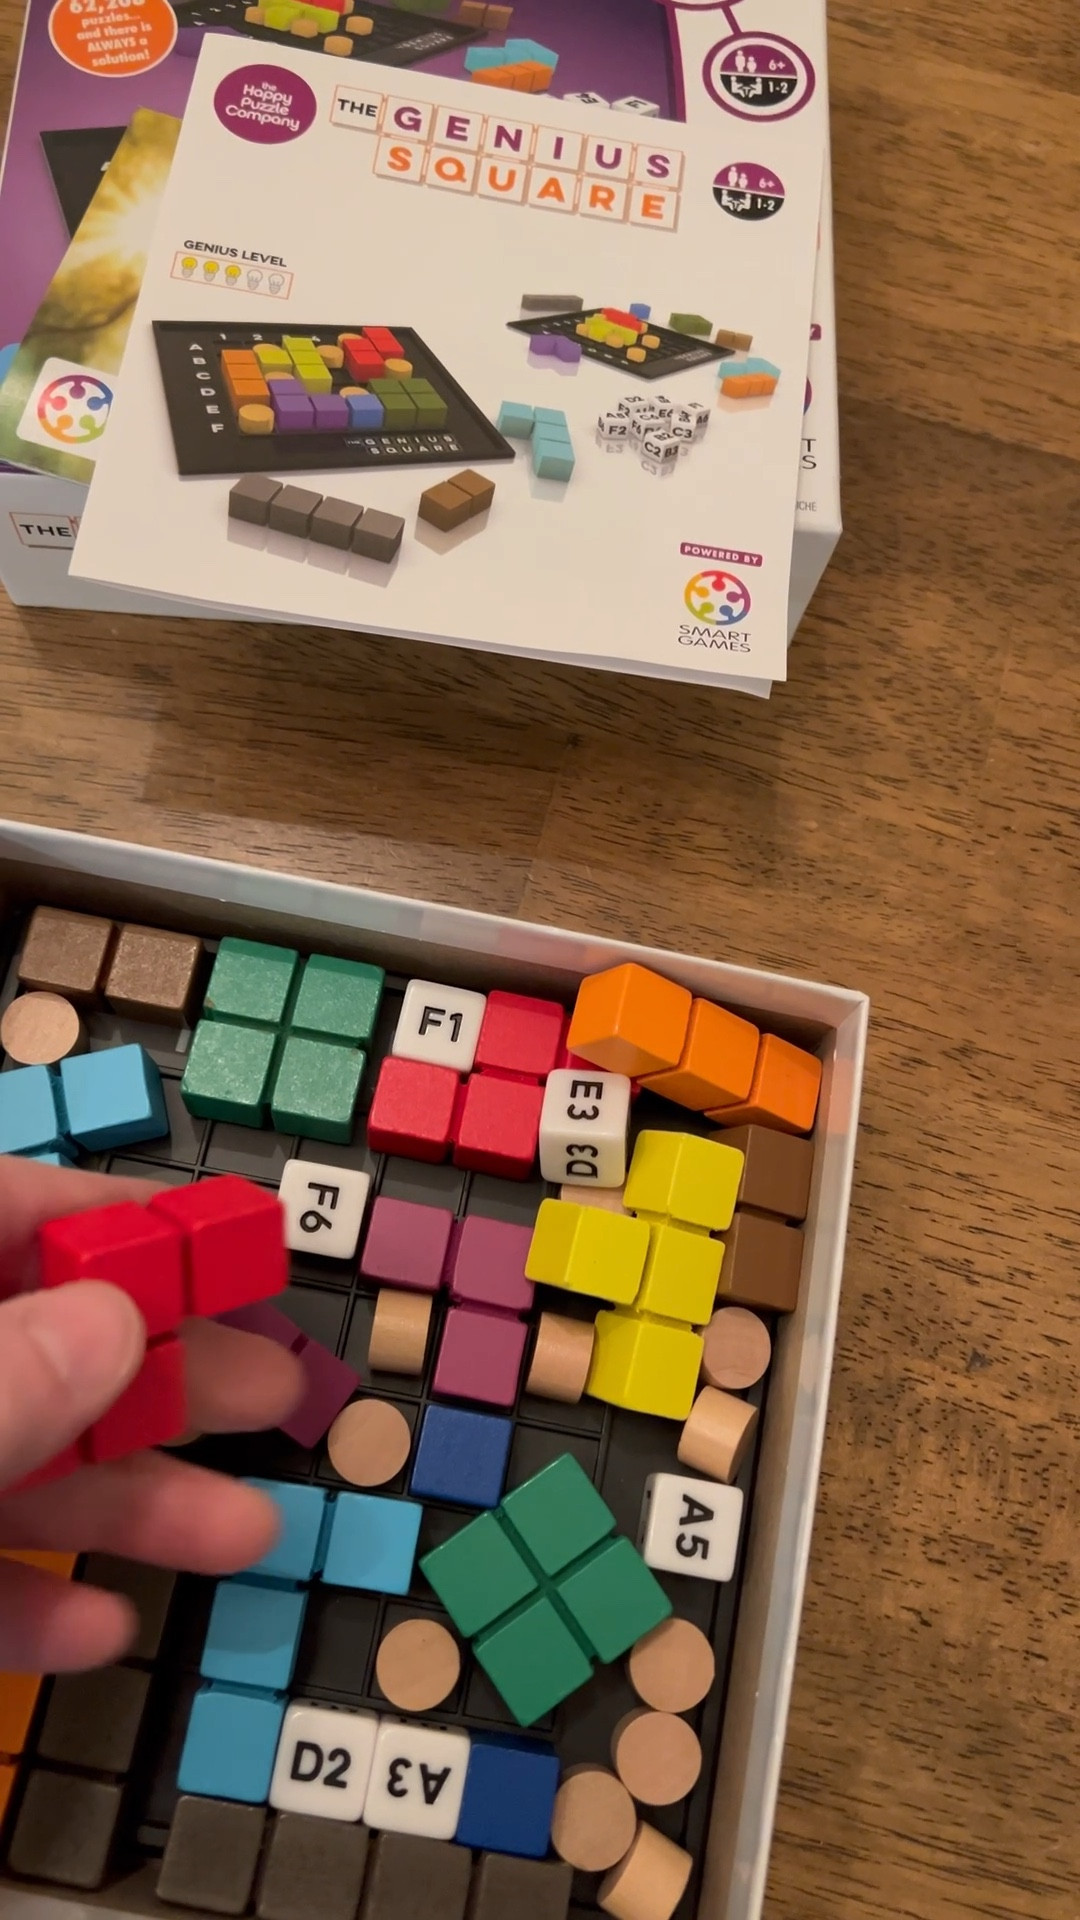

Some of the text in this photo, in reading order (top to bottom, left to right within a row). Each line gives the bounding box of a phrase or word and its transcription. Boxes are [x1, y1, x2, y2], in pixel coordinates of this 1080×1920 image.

[76, 21, 152, 40] and there is
[87, 37, 148, 52] ALWAYS a
[92, 49, 150, 67] solution!
[768, 59, 786, 71] 6+
[261, 81, 277, 92] the
[768, 81, 788, 94] 1-2
[242, 84, 293, 107] Happy
[240, 97, 290, 116] Puzzle
[225, 105, 300, 132] Company
[337, 98, 671, 178] THE GENIUS
[387, 146, 666, 220] SQUARE
[759, 178, 775, 189] 6+
[757, 198, 775, 211] 1-2
[184, 240, 287, 267] GENIUS LEVEL
[192, 357, 207, 365] B
[196, 372, 211, 380] C
[200, 388, 216, 396] D
[206, 405, 220, 414] E
[211, 424, 224, 433] F
[608, 425, 627, 435] F2
[672, 426, 693, 439] C3
[365, 435, 452, 446] GENIUS
[644, 441, 661, 457] C2
[370, 444, 458, 455] SQUARE
[19, 523, 73, 537] THE
[684, 545, 759, 564] POWERED BY
[679, 624, 751, 642] SMART
[678, 636, 751, 653] GAMES
[418, 1005, 463, 1043] F1
[566, 1080, 604, 1121] E3
[565, 1144, 599, 1179] D3
[300, 1181, 340, 1233] F6
[675, 1493, 714, 1560] A5
[290, 1740, 352, 1789] D2
[386, 1757, 452, 1805] A3
